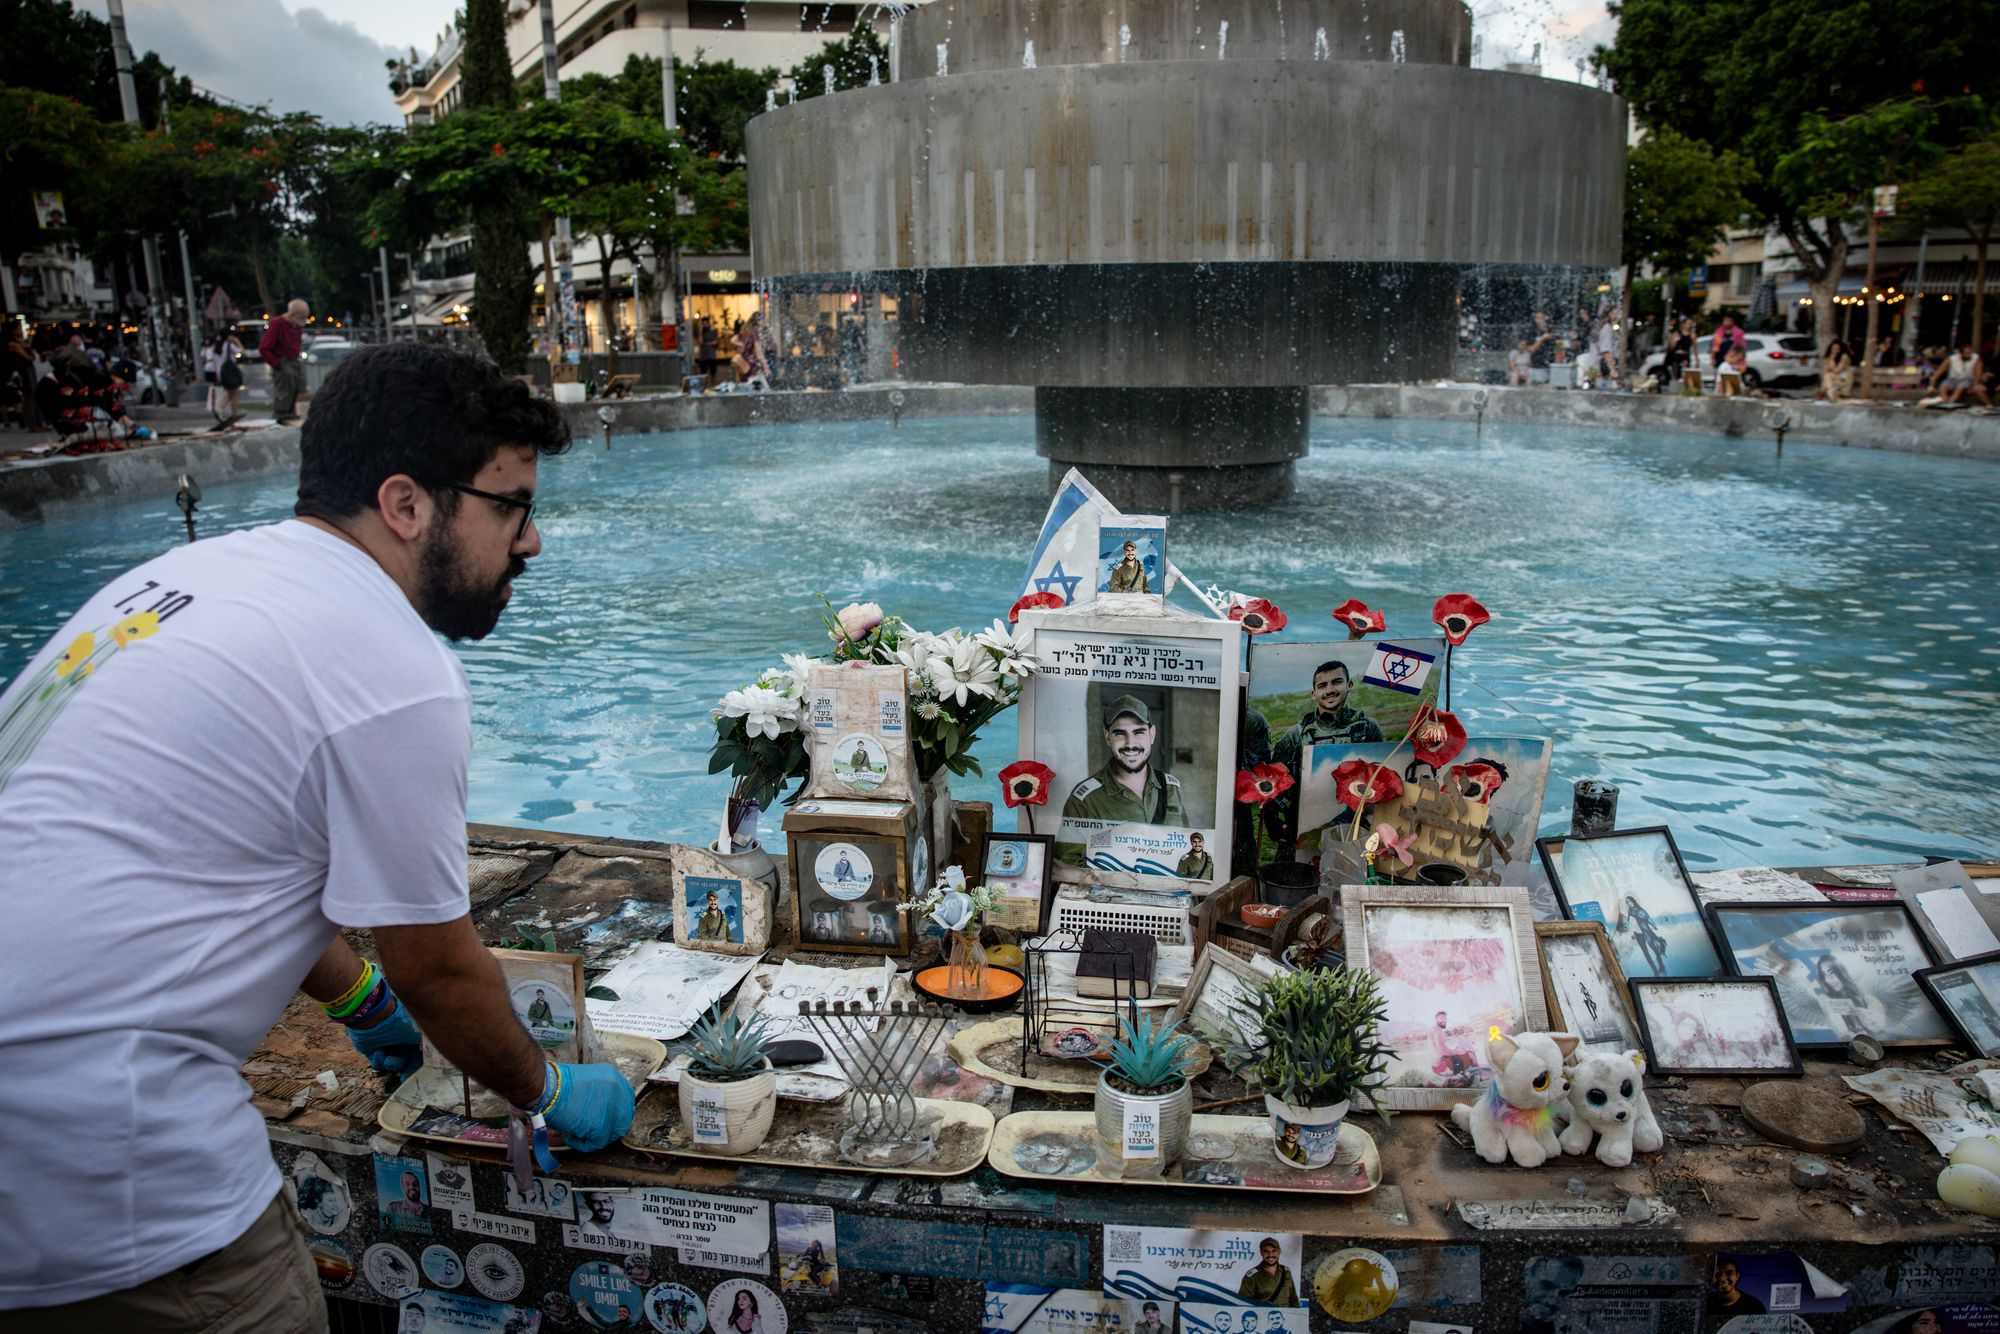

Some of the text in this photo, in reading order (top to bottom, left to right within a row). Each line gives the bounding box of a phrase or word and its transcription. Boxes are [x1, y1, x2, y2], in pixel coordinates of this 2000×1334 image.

[1074, 643, 1181, 657] לזיכרו של גיבור ישראל
[1053, 651, 1203, 671] רב-סרן גיא נזרי הי"ד
[1040, 665, 1216, 685] שחרף נפשו בהצלת פקודיו מטנק בוער
[1115, 836, 1140, 844] ארצנו
[699, 1115, 715, 1123] בעד
[1133, 1113, 1151, 1123] טוב
[650, 1194, 685, 1206] והמידות
[643, 1204, 660, 1213] הזה
[699, 1211, 736, 1223] מהדהדים
[695, 1220, 717, 1232] לנצח
[1226, 1237, 1251, 1250] טוב
[1147, 1246, 1255, 1260] לחיות בעד ארצנו
[1946, 1267, 1964, 1276] הם
[1970, 1267, 2000, 1276] מים
[579, 1274, 631, 1293] SMILE LIKE
[1937, 1278, 1963, 1289] דרך
[1980, 1278, 2000, 1289] רך
[594, 1293, 619, 1307] OMRI
